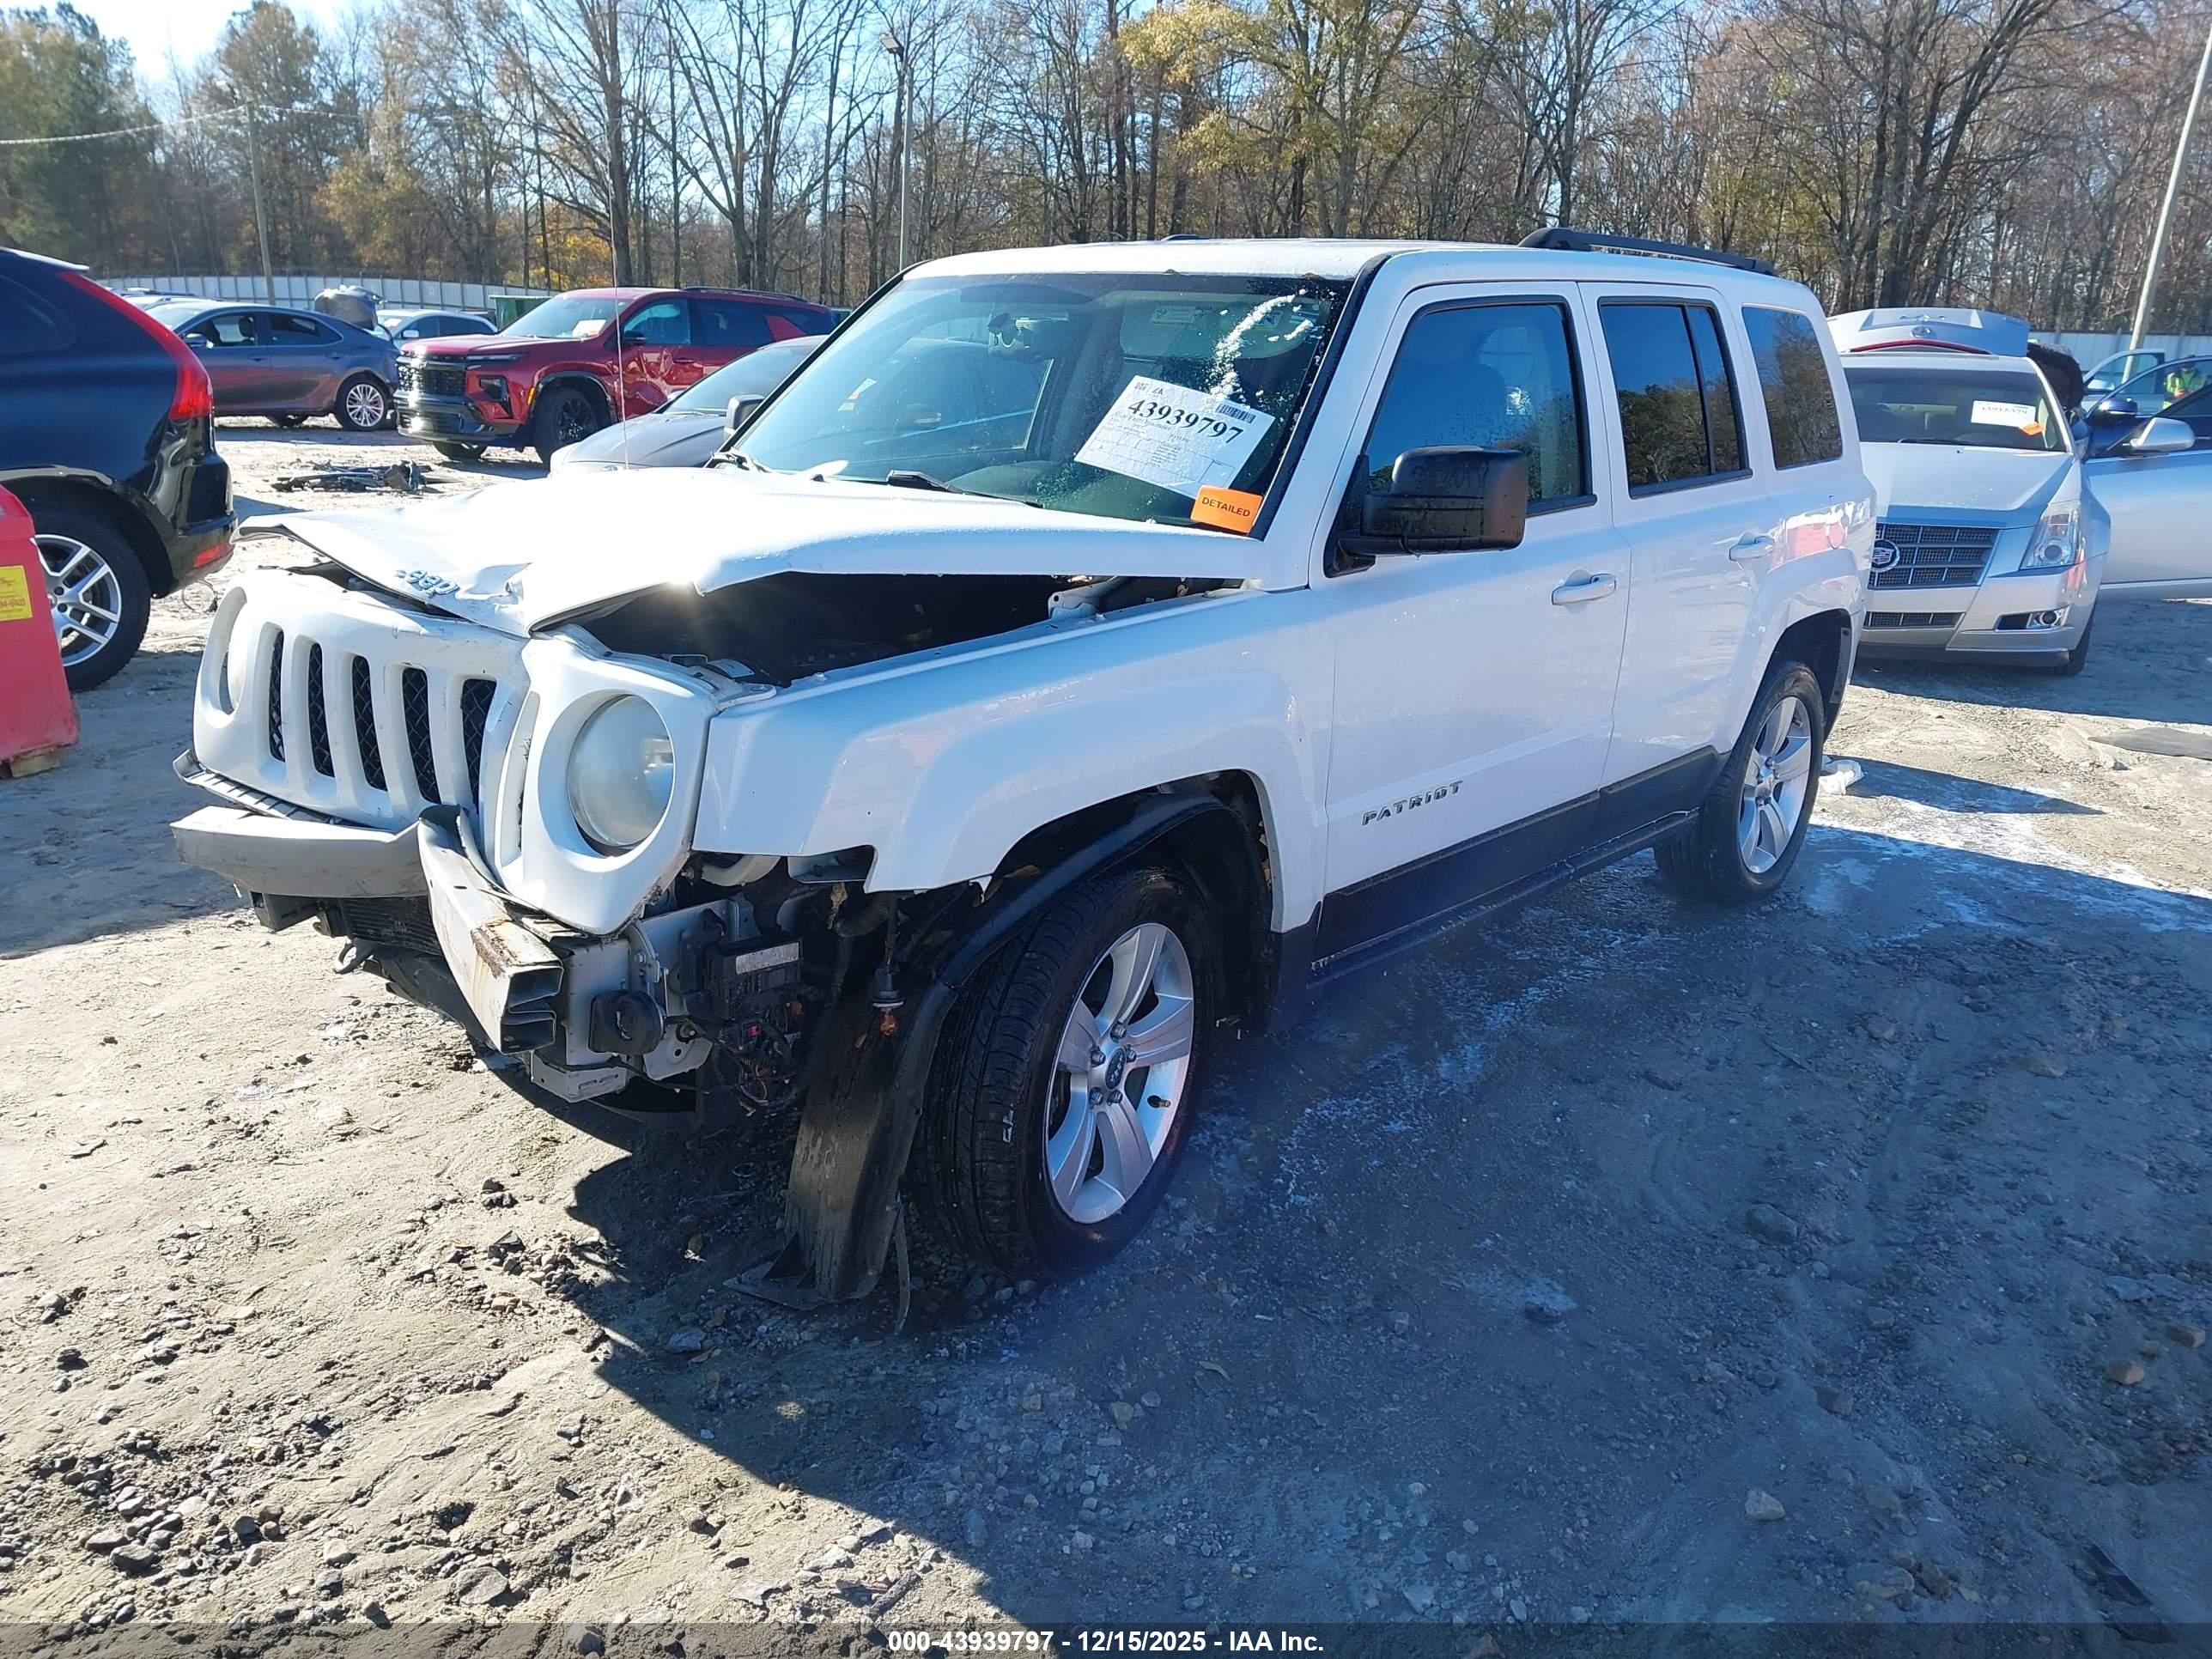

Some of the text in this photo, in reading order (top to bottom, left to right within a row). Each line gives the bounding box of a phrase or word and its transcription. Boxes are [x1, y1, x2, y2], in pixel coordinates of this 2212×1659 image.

[1127, 399, 1244, 443] 43939797
[1201, 496, 1251, 517] DETAILED
[1362, 780, 1463, 826] PATRIOT
